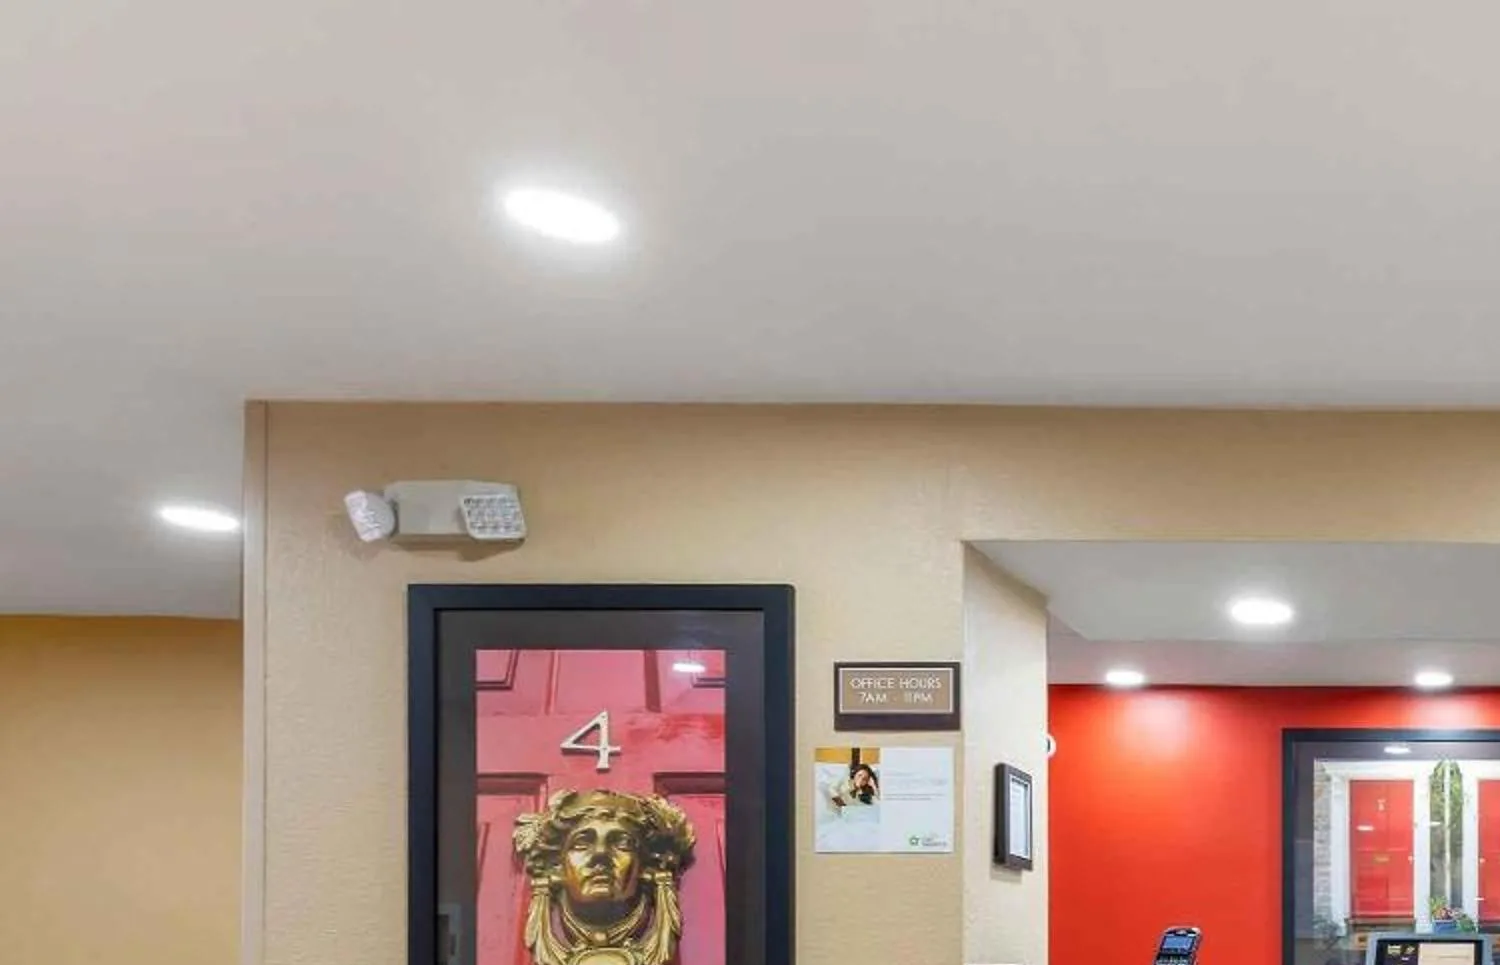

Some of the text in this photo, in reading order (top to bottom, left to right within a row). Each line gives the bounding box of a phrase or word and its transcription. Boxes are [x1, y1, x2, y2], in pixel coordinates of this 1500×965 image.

[850, 677, 942, 689] OFFICE HOURS
[858, 691, 888, 704] 7AM
[560, 711, 621, 769] 4
